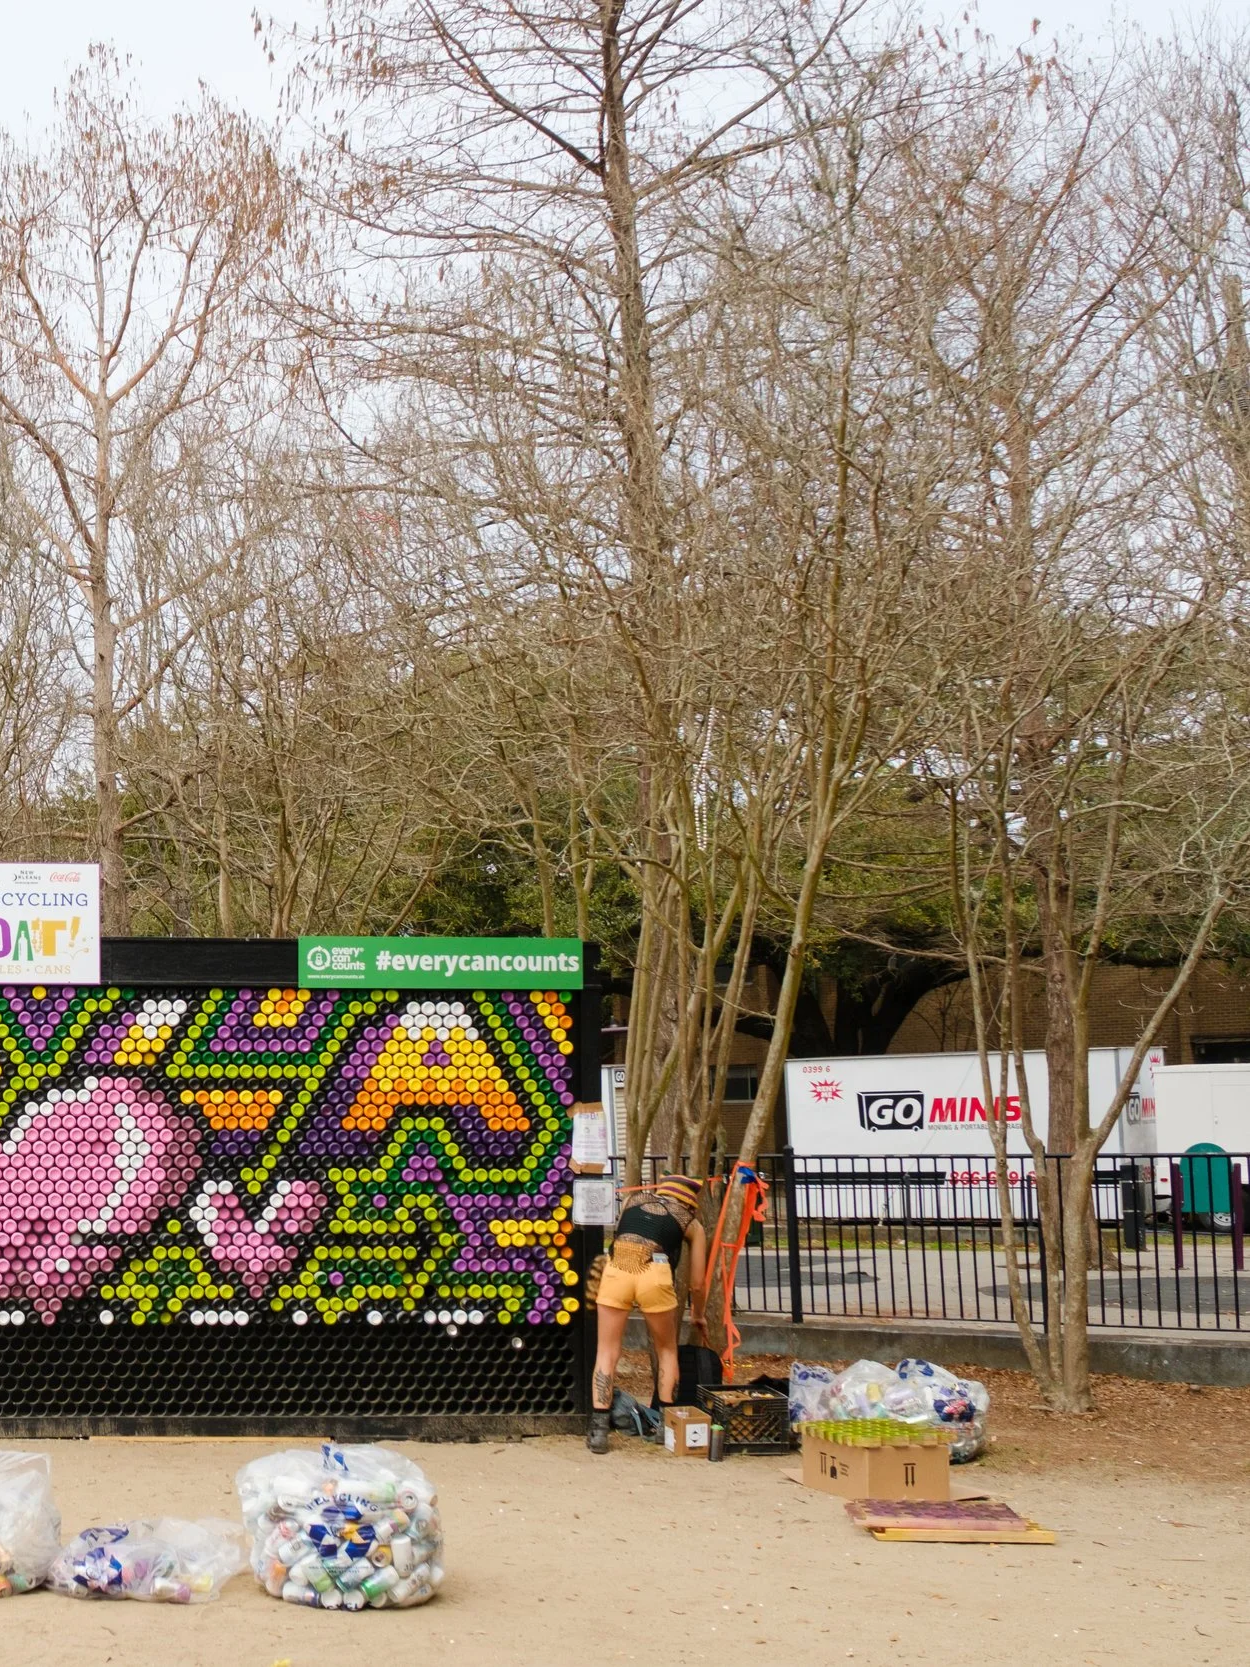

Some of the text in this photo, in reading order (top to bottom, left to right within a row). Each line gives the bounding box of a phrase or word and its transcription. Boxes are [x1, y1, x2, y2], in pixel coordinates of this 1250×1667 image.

[331, 954, 351, 962] can
[331, 961, 366, 970] counts
[375, 950, 579, 977] #everycancounts
[34, 965, 71, 975] CANS
[868, 1097, 922, 1126] GO
